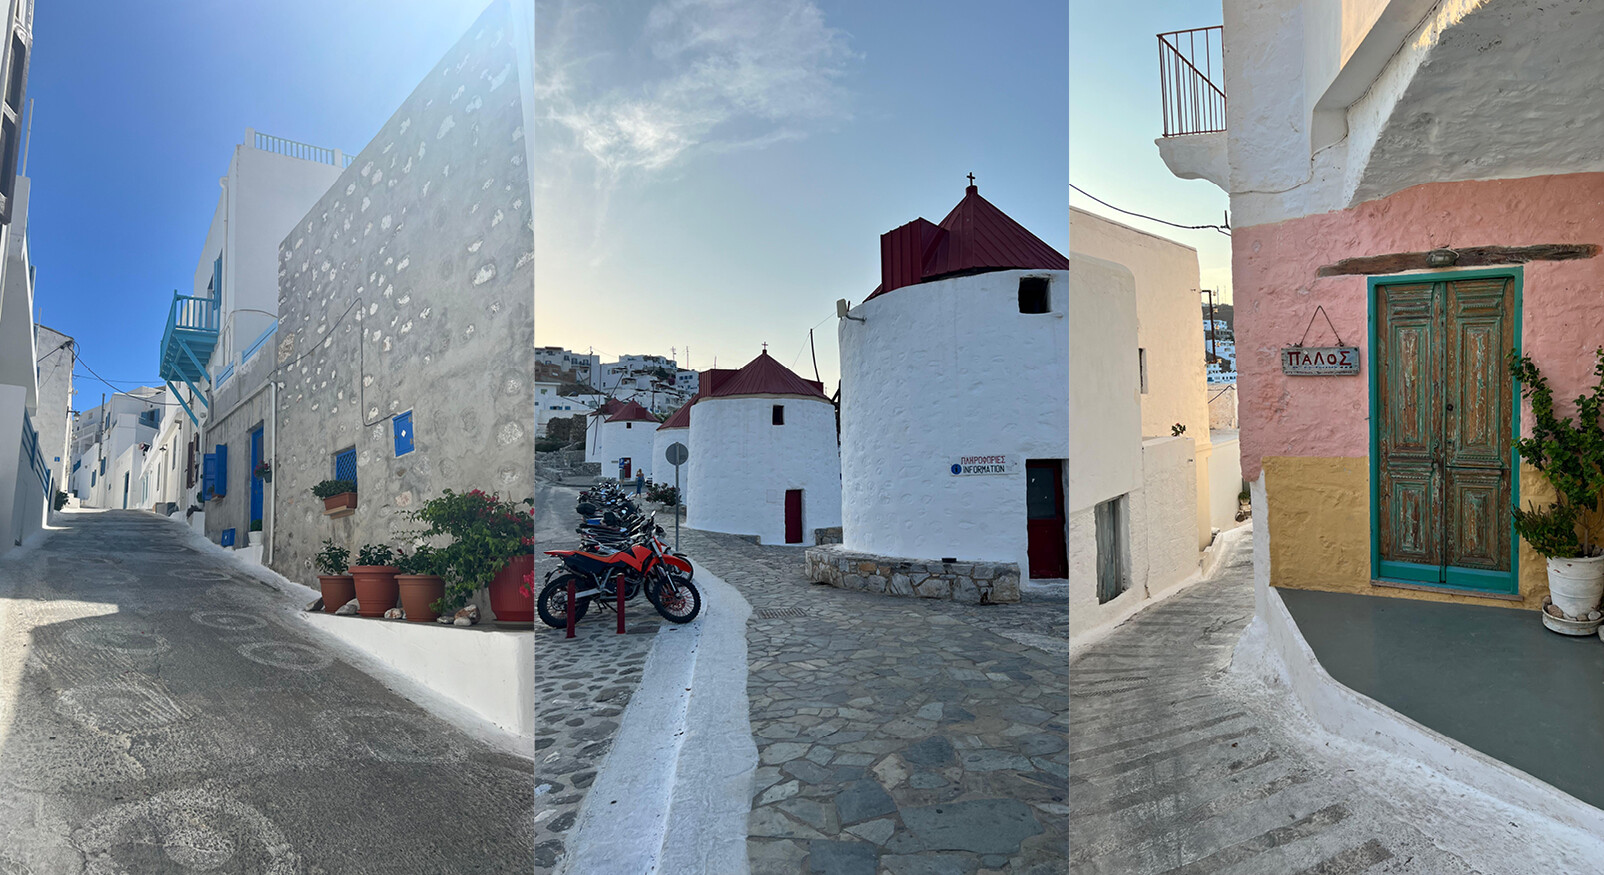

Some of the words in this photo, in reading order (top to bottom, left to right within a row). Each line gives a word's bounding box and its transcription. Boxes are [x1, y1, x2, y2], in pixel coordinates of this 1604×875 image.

[1287, 351, 1352, 366] ΠΑΛΟΣ
[961, 456, 1005, 464] ΠΛΗΡΟΦΟΡΙΕΣ
[963, 465, 1005, 474] INFORMATION
